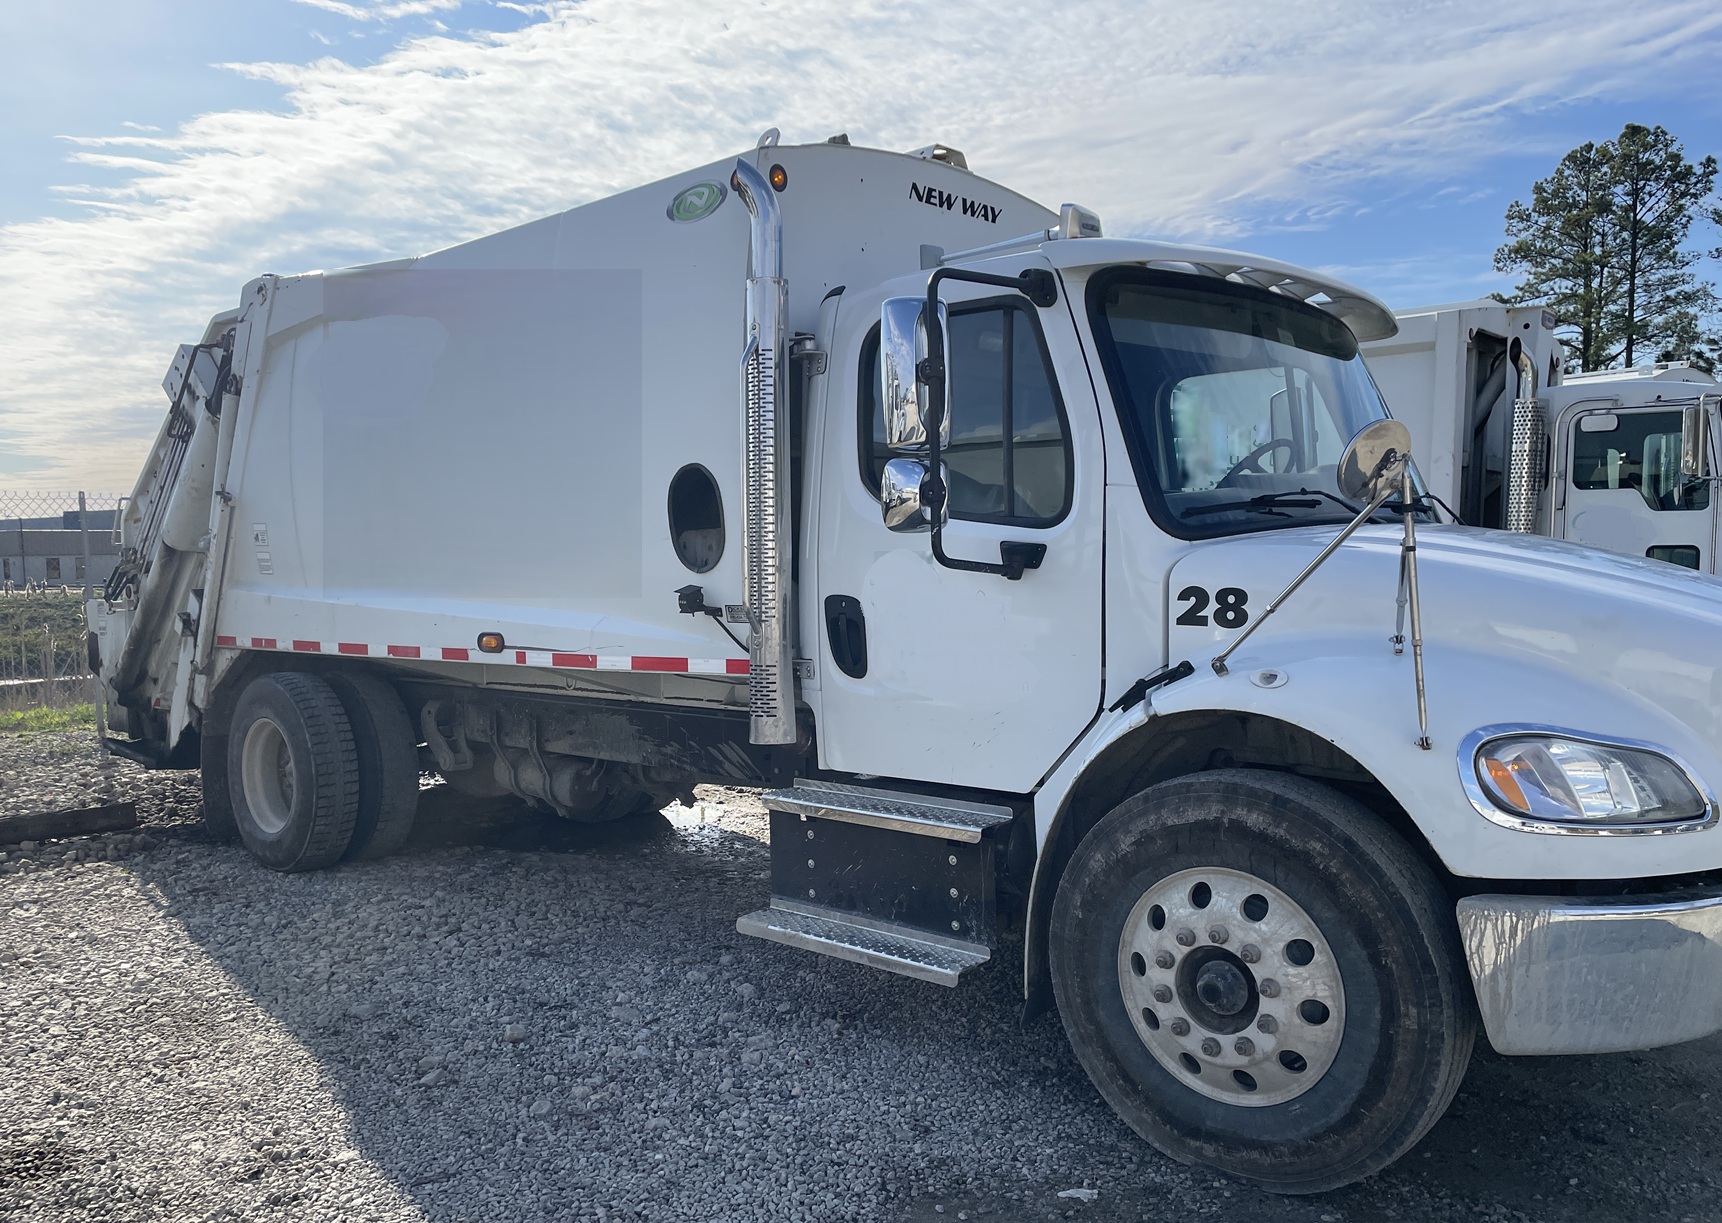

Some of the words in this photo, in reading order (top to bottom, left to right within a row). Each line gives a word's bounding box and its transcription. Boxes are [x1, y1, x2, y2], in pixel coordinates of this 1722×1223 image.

[909, 181, 959, 211] NEW
[961, 197, 1003, 224] WAY
[1176, 585, 1249, 629] 28
